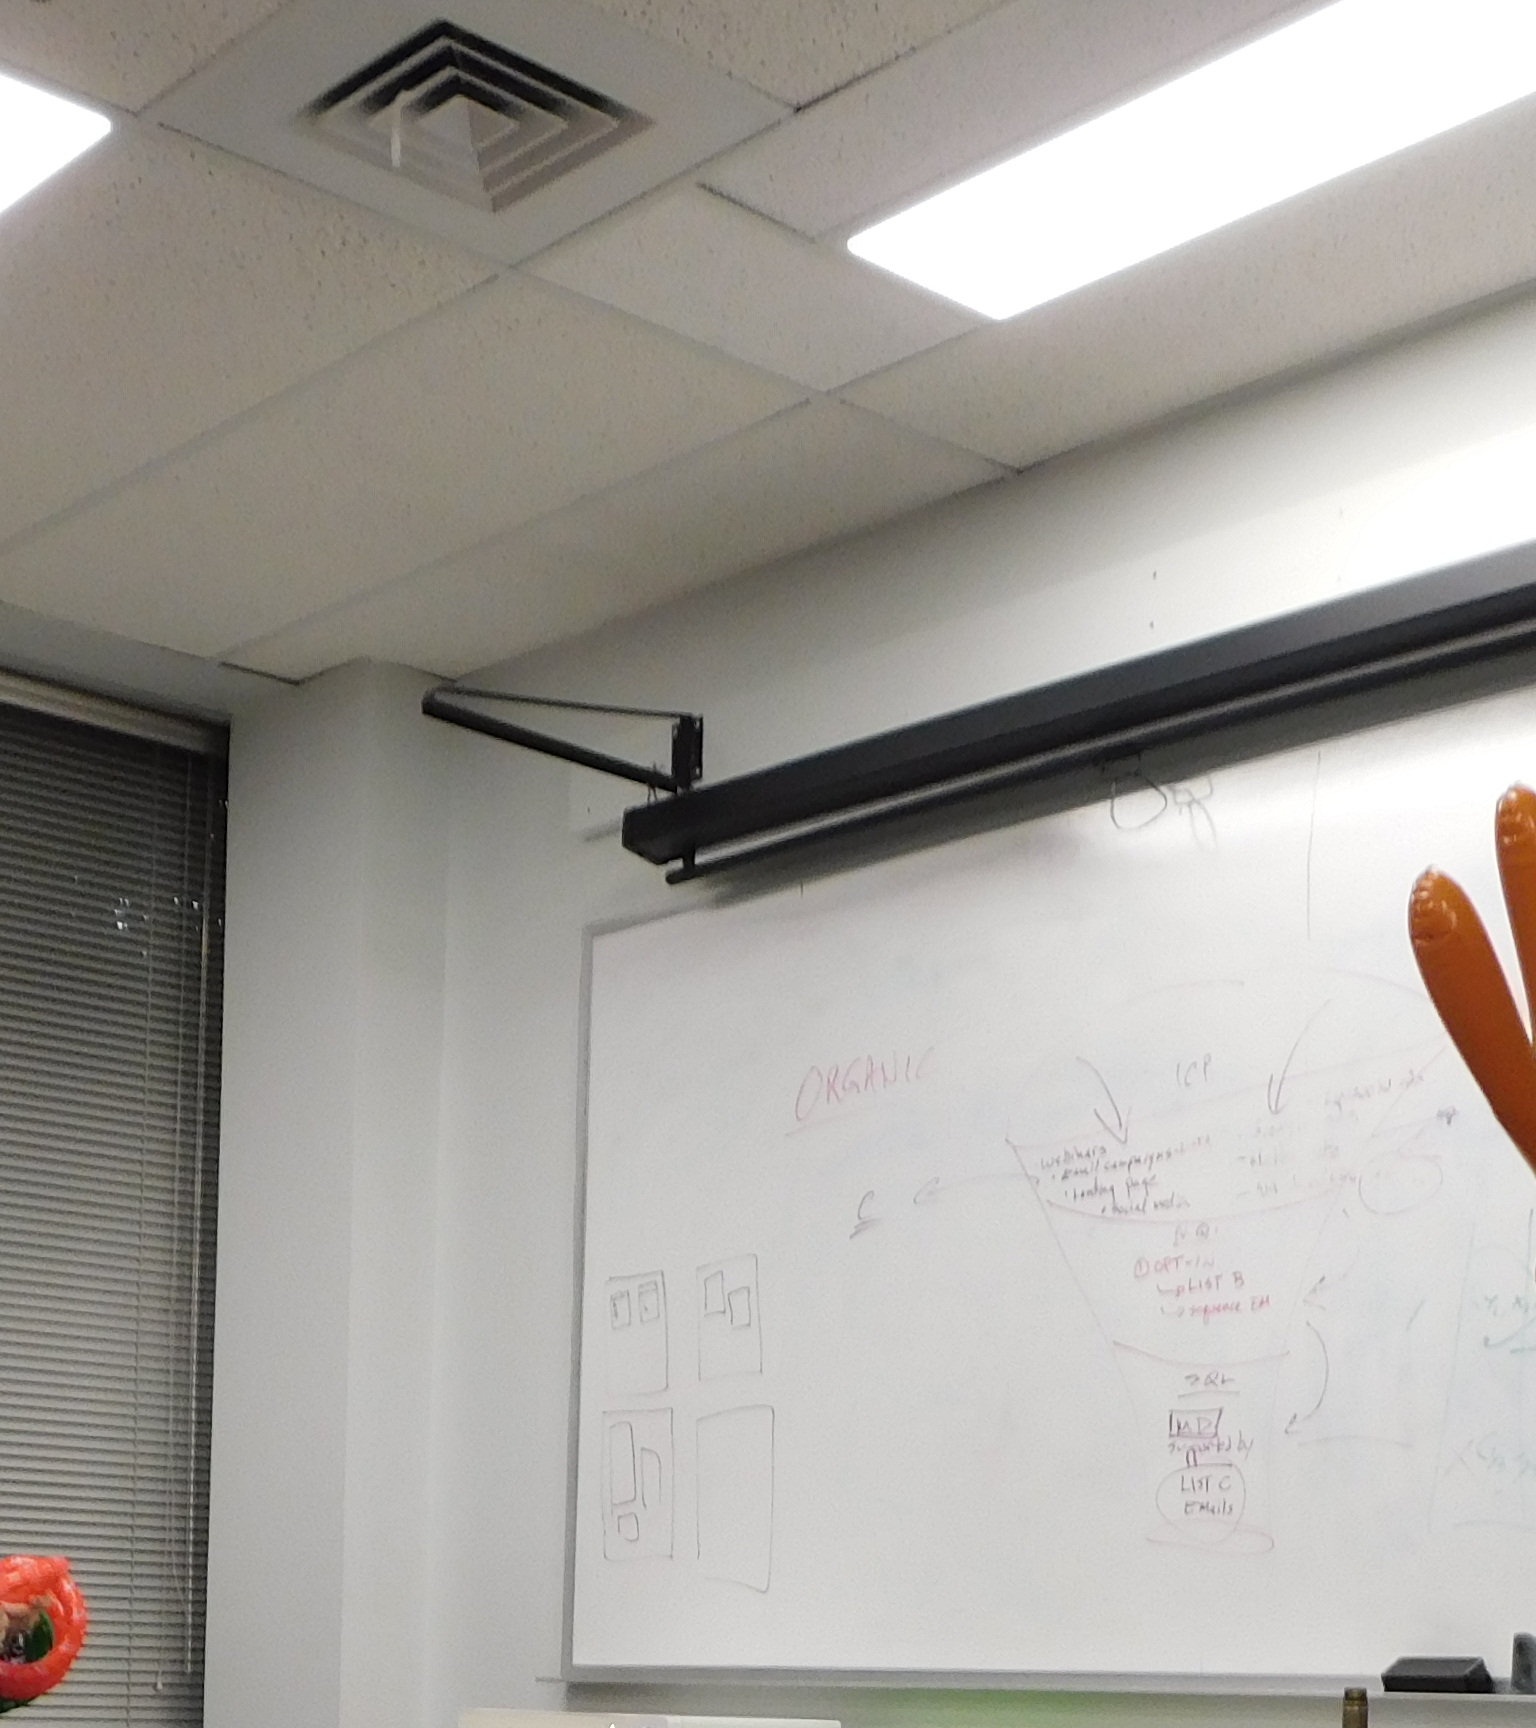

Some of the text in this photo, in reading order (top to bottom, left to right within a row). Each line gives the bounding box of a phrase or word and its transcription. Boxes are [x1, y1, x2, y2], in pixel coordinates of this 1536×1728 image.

[794, 1045, 935, 1122] ORGANIC
[1175, 1052, 1212, 1087] ICP
[1181, 1474, 1211, 1493] LIST
